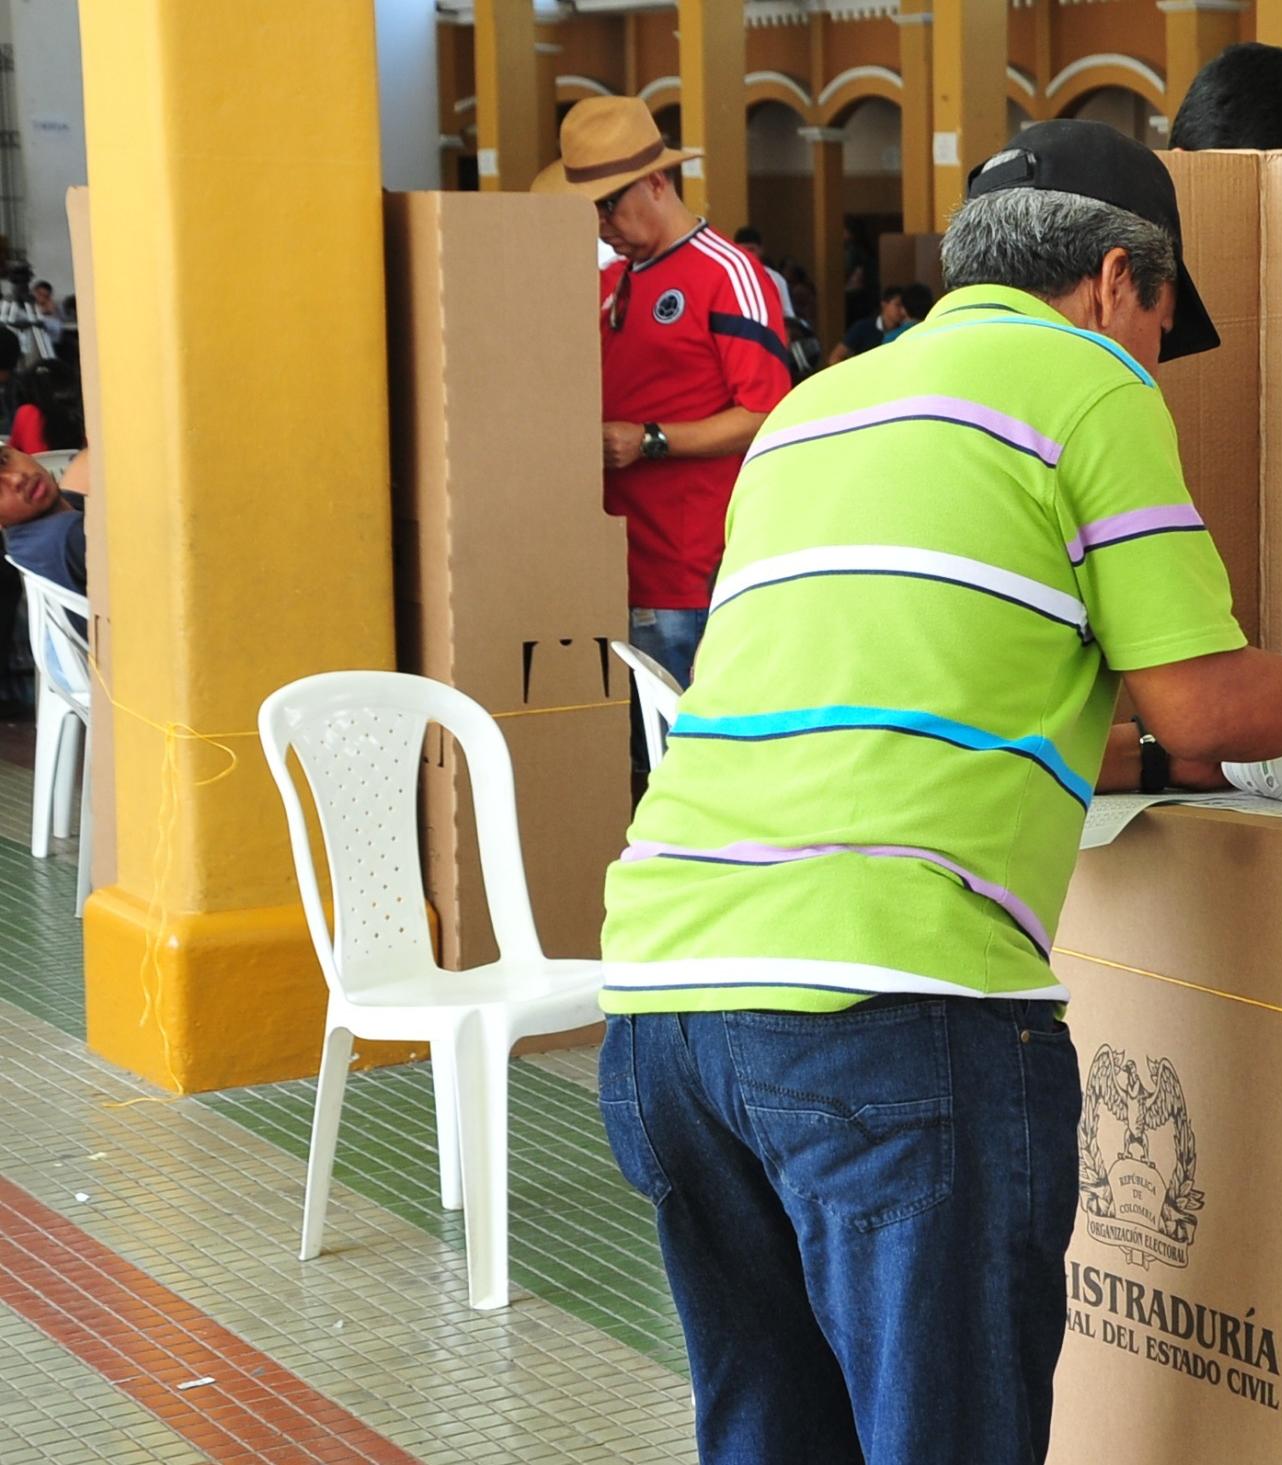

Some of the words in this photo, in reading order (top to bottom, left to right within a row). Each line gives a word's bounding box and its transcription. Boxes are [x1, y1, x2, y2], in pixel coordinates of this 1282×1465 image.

[1119, 1173, 1156, 1196] REPÚBLICA
[1132, 1189, 1143, 1200] DE
[1120, 1203, 1156, 1225] COLOMBIA
[1090, 1221, 1143, 1246] ORGANIZACIÓN
[1144, 1235, 1186, 1264] ELECTORAL
[1066, 1261, 1281, 1376] ISTRADURÍA
[1102, 1319, 1139, 1354] DEL
[1146, 1336, 1221, 1386] ESTADO
[1227, 1368, 1280, 1410] CIVIL
